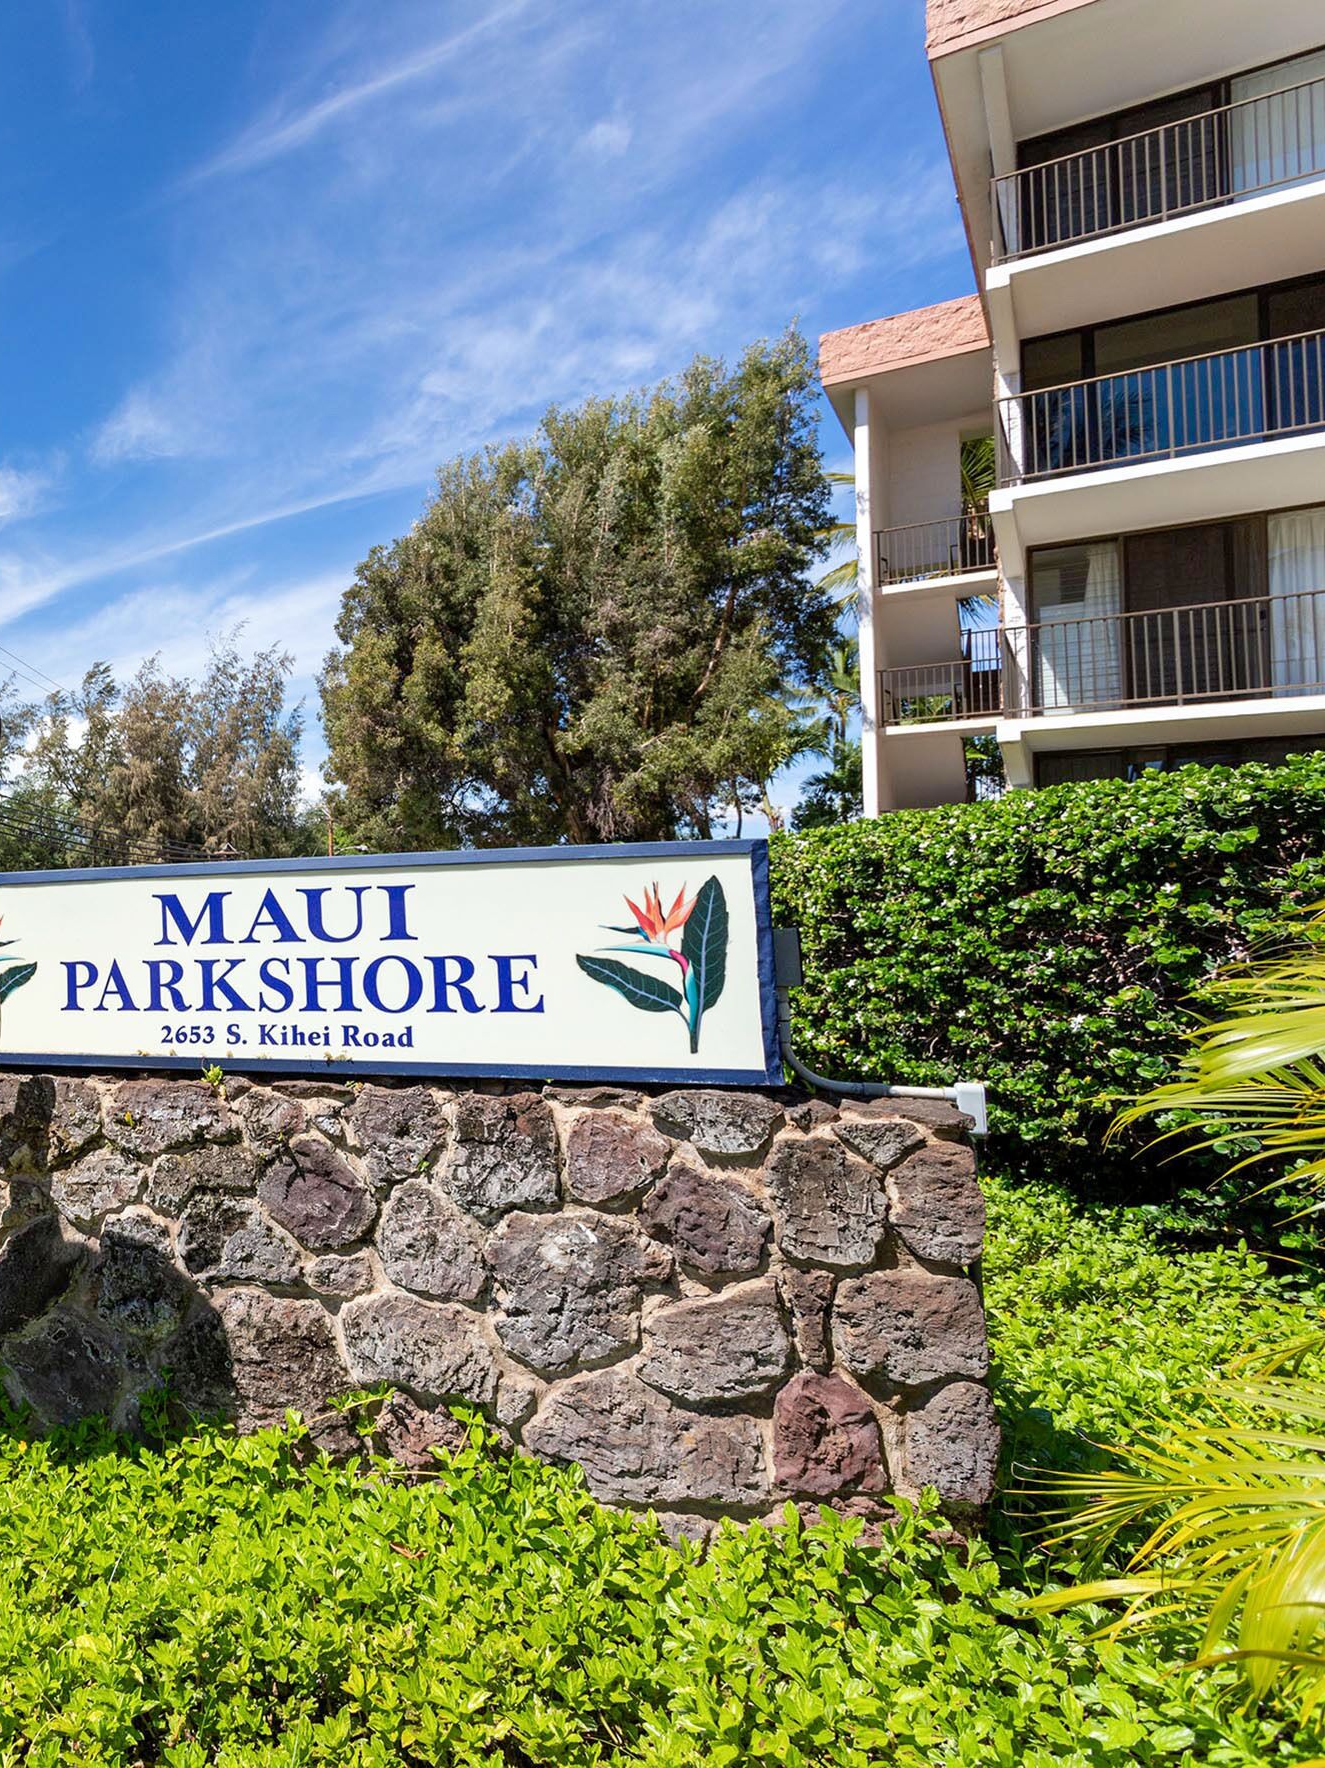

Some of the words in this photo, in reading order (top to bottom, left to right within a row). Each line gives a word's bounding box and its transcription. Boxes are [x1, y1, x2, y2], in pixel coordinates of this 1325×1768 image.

[152, 884, 419, 945] MAUI
[60, 954, 545, 1014] PARKSHORE
[160, 1024, 216, 1044] 2653
[226, 1023, 248, 1045] S.
[258, 1024, 331, 1047] Kihei
[341, 1025, 414, 1048] Road
